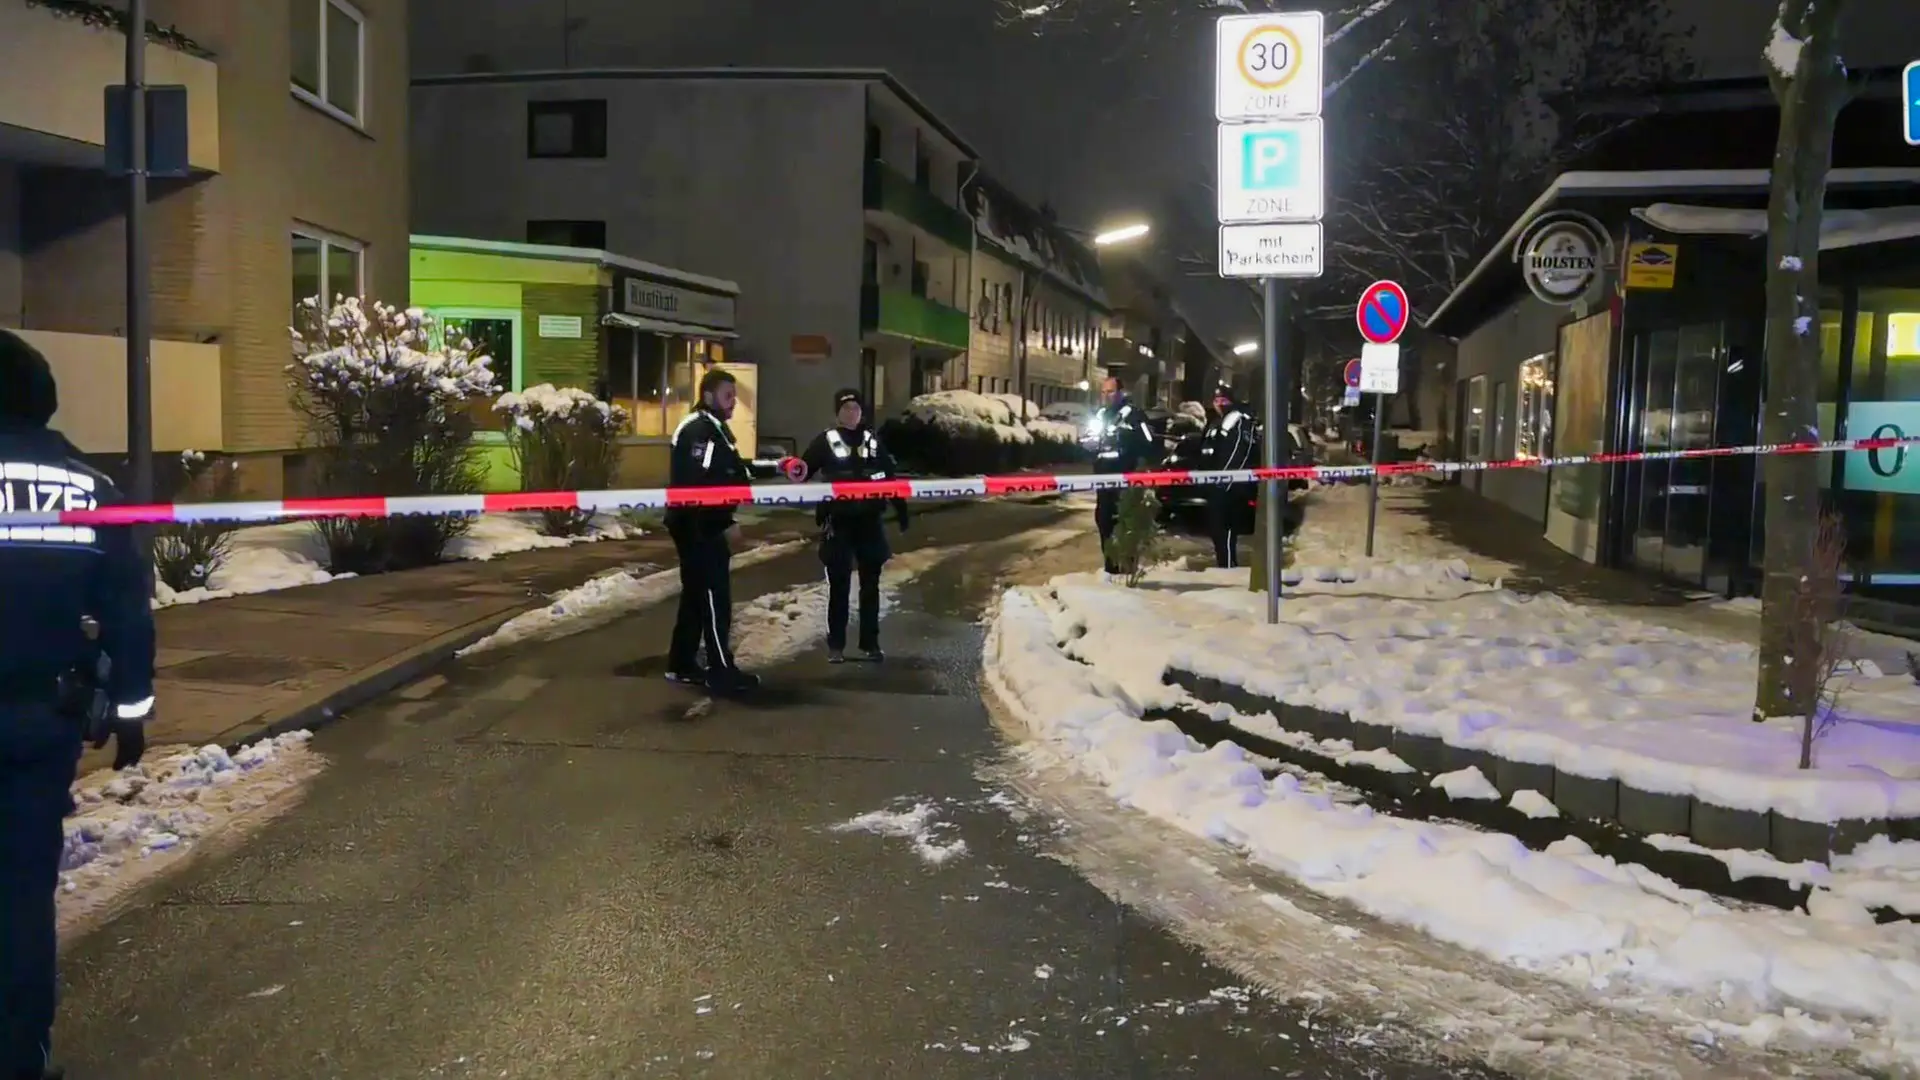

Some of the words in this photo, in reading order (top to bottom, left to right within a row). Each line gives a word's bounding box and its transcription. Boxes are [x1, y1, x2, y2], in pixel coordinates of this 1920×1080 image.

[1251, 42, 1288, 71] 30
[1255, 140, 1287, 184] P
[1246, 197, 1293, 214] ZONE
[1259, 236, 1282, 248] mit
[1228, 251, 1314, 266] Parkschein
[1531, 255, 1596, 269] HOLSTEN
